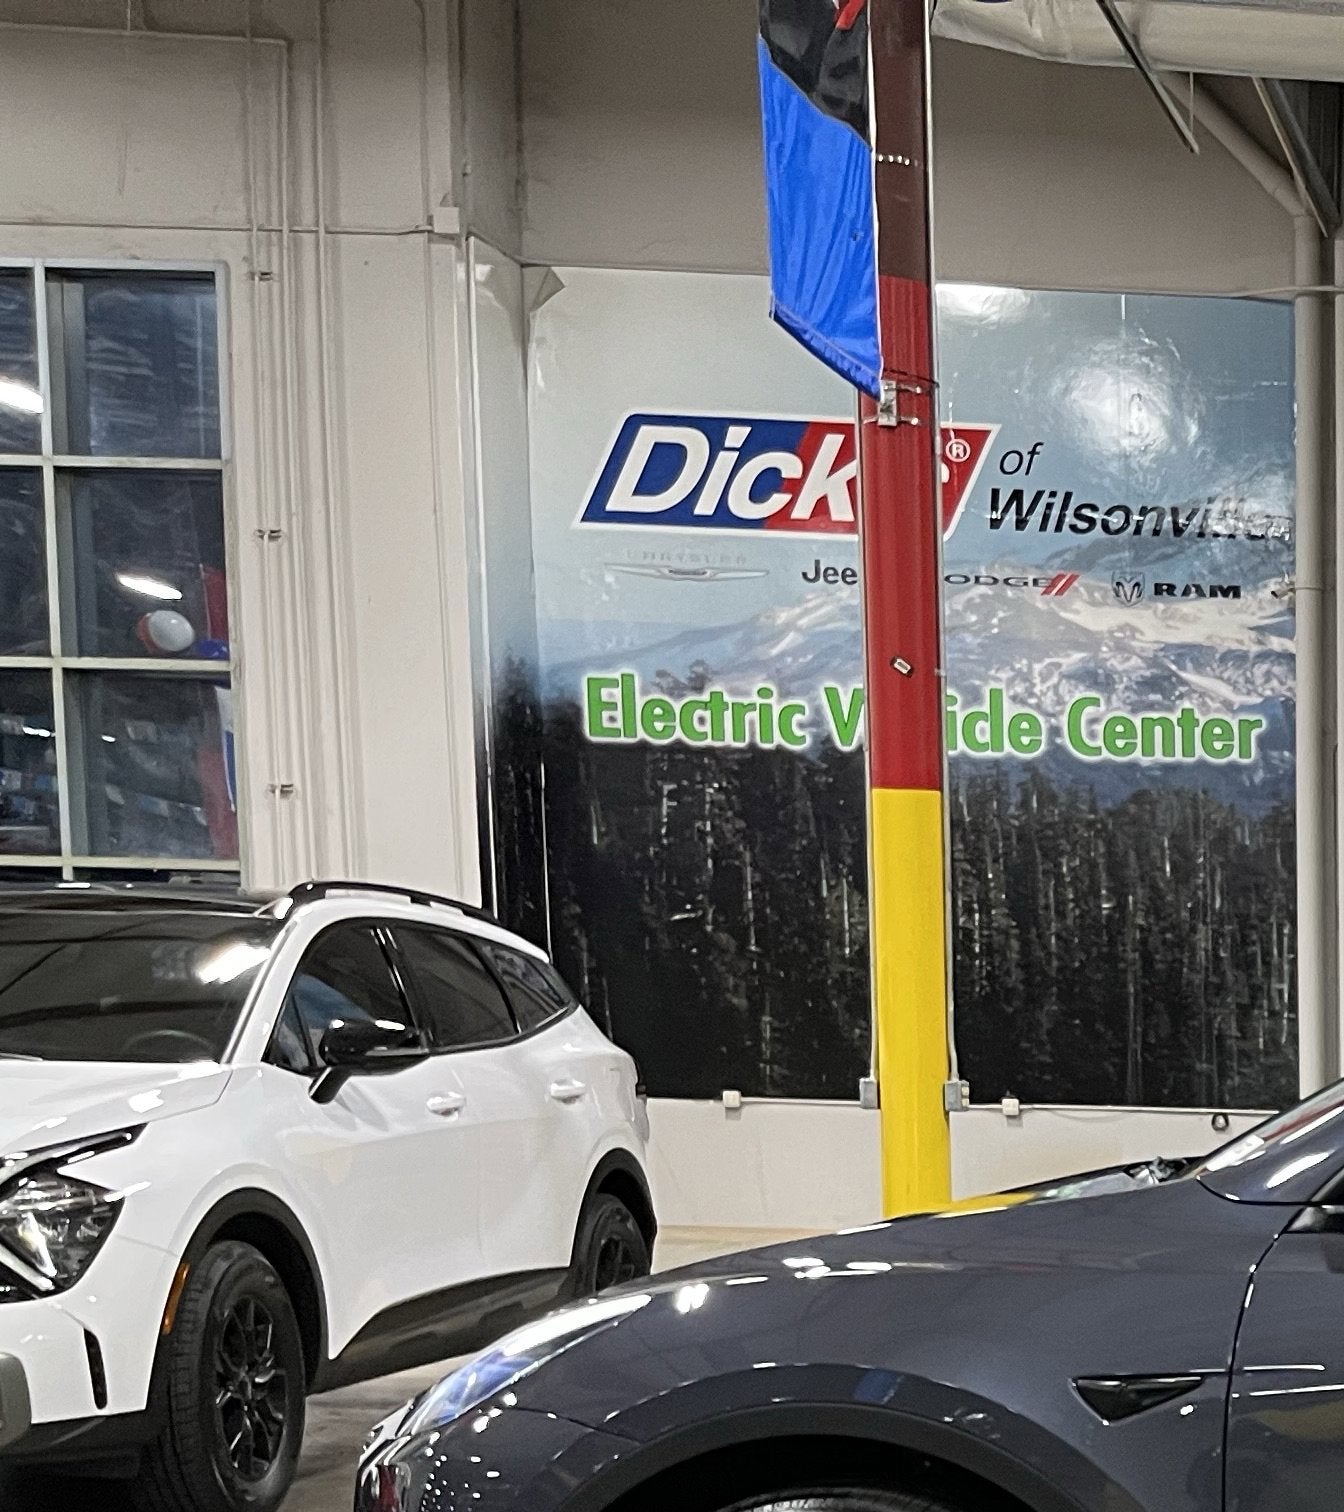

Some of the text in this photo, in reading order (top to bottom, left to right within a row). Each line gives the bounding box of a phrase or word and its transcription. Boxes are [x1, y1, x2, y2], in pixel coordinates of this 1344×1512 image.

[605, 425, 1044, 522] Dick of
[802, 559, 858, 586] Jee
[944, 573, 1053, 588] ODGE
[1154, 582, 1242, 600] RAM
[587, 673, 1263, 760] Electric Vicle Center
